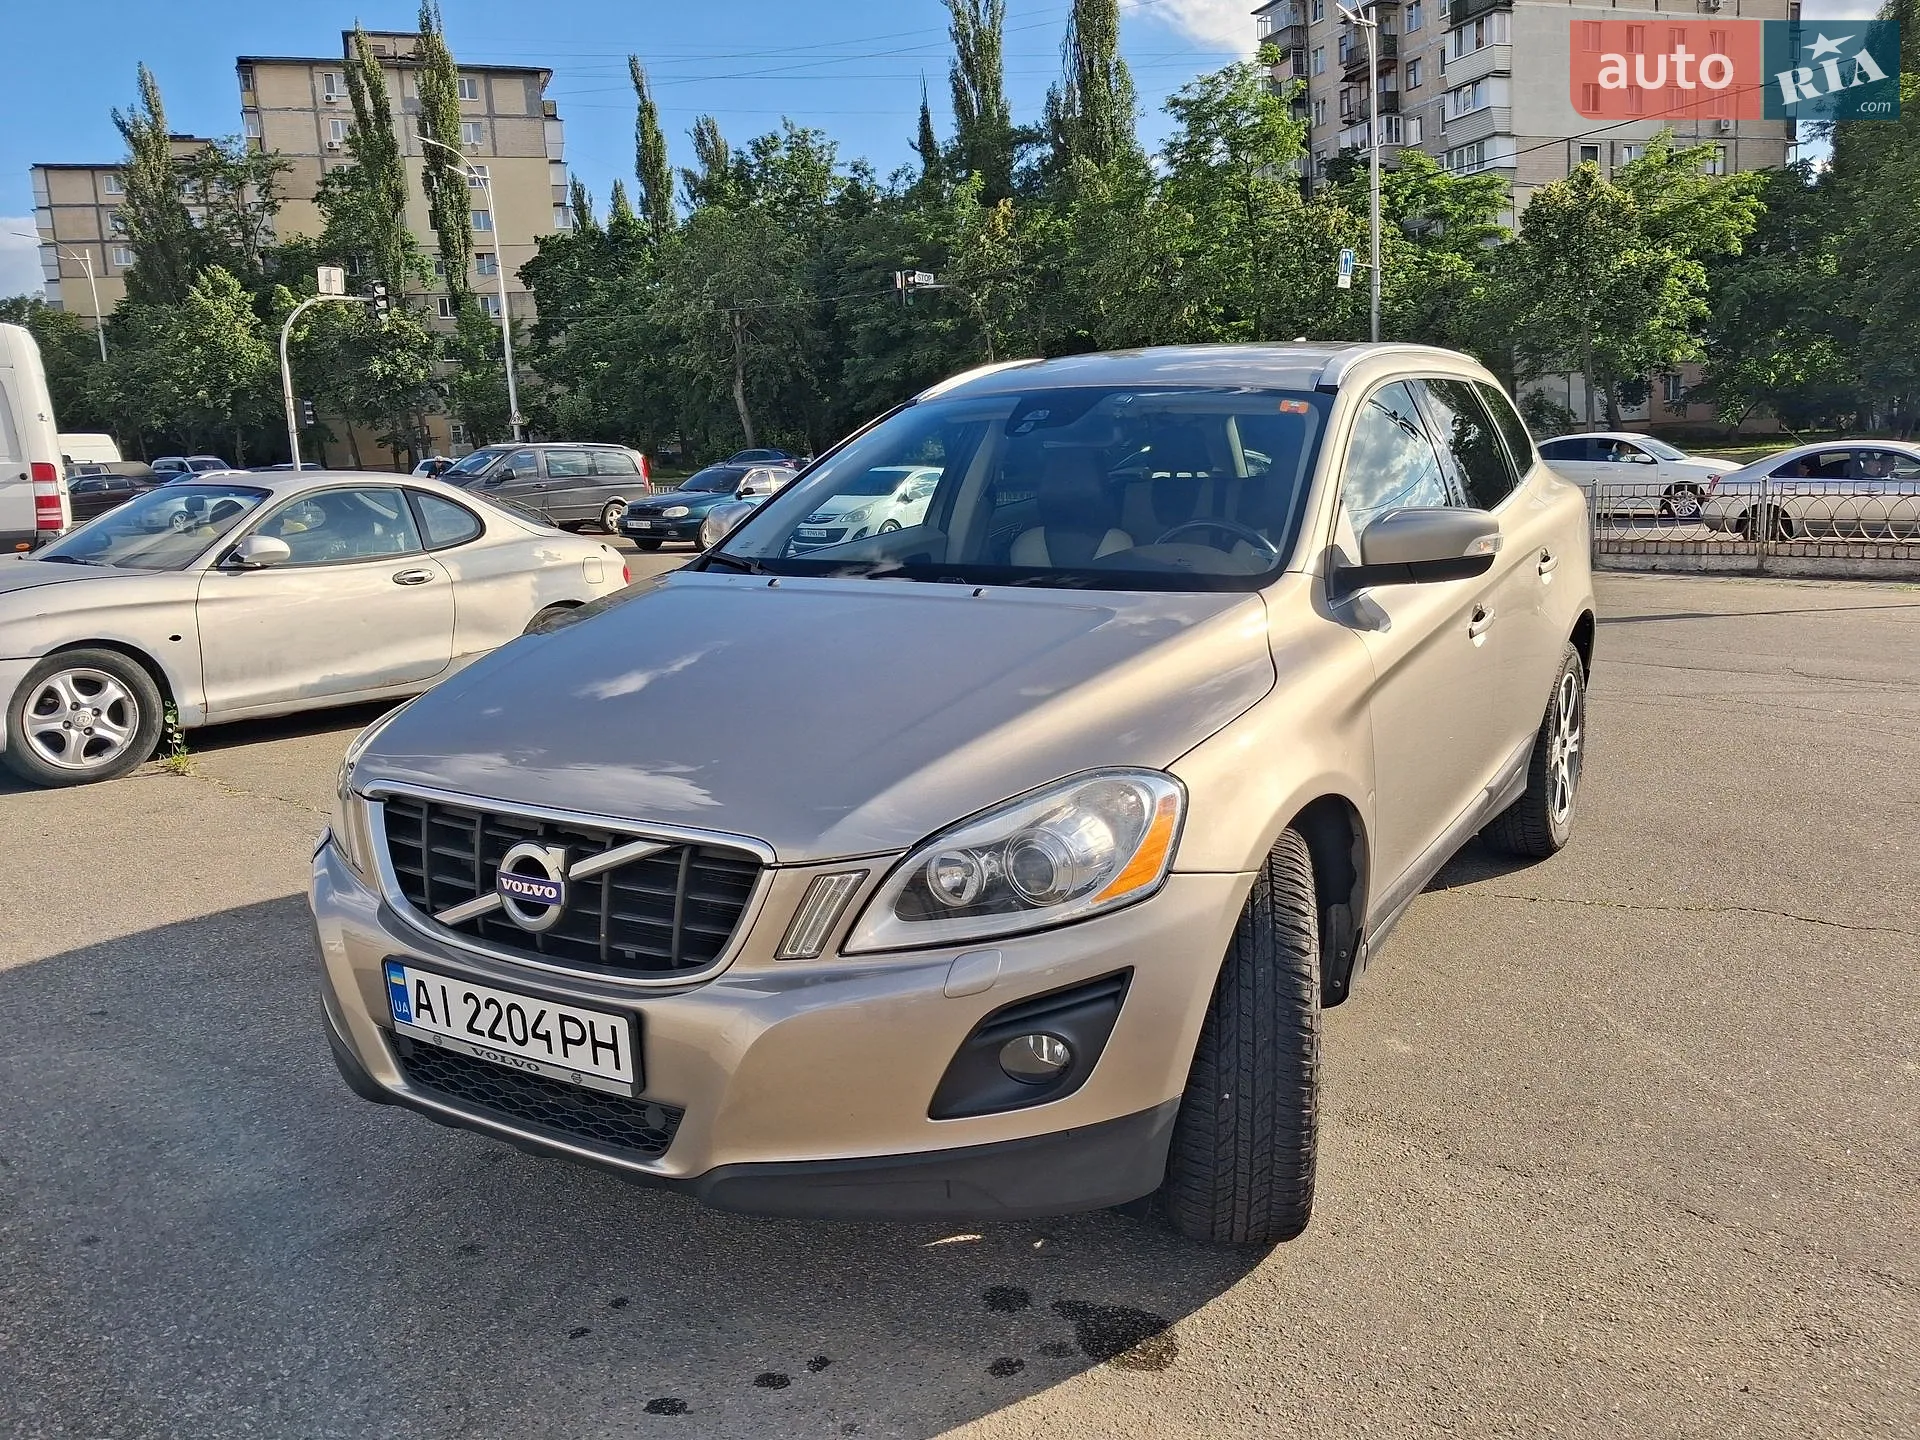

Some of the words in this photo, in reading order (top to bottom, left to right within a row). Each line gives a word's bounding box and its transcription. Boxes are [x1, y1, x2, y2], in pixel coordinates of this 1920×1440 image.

[916, 273, 932, 282] STOP
[500, 877, 557, 899] VOLVO
[394, 999, 410, 1016] UA
[415, 979, 452, 1028] AI
[470, 1047, 540, 1072] VOLVO
